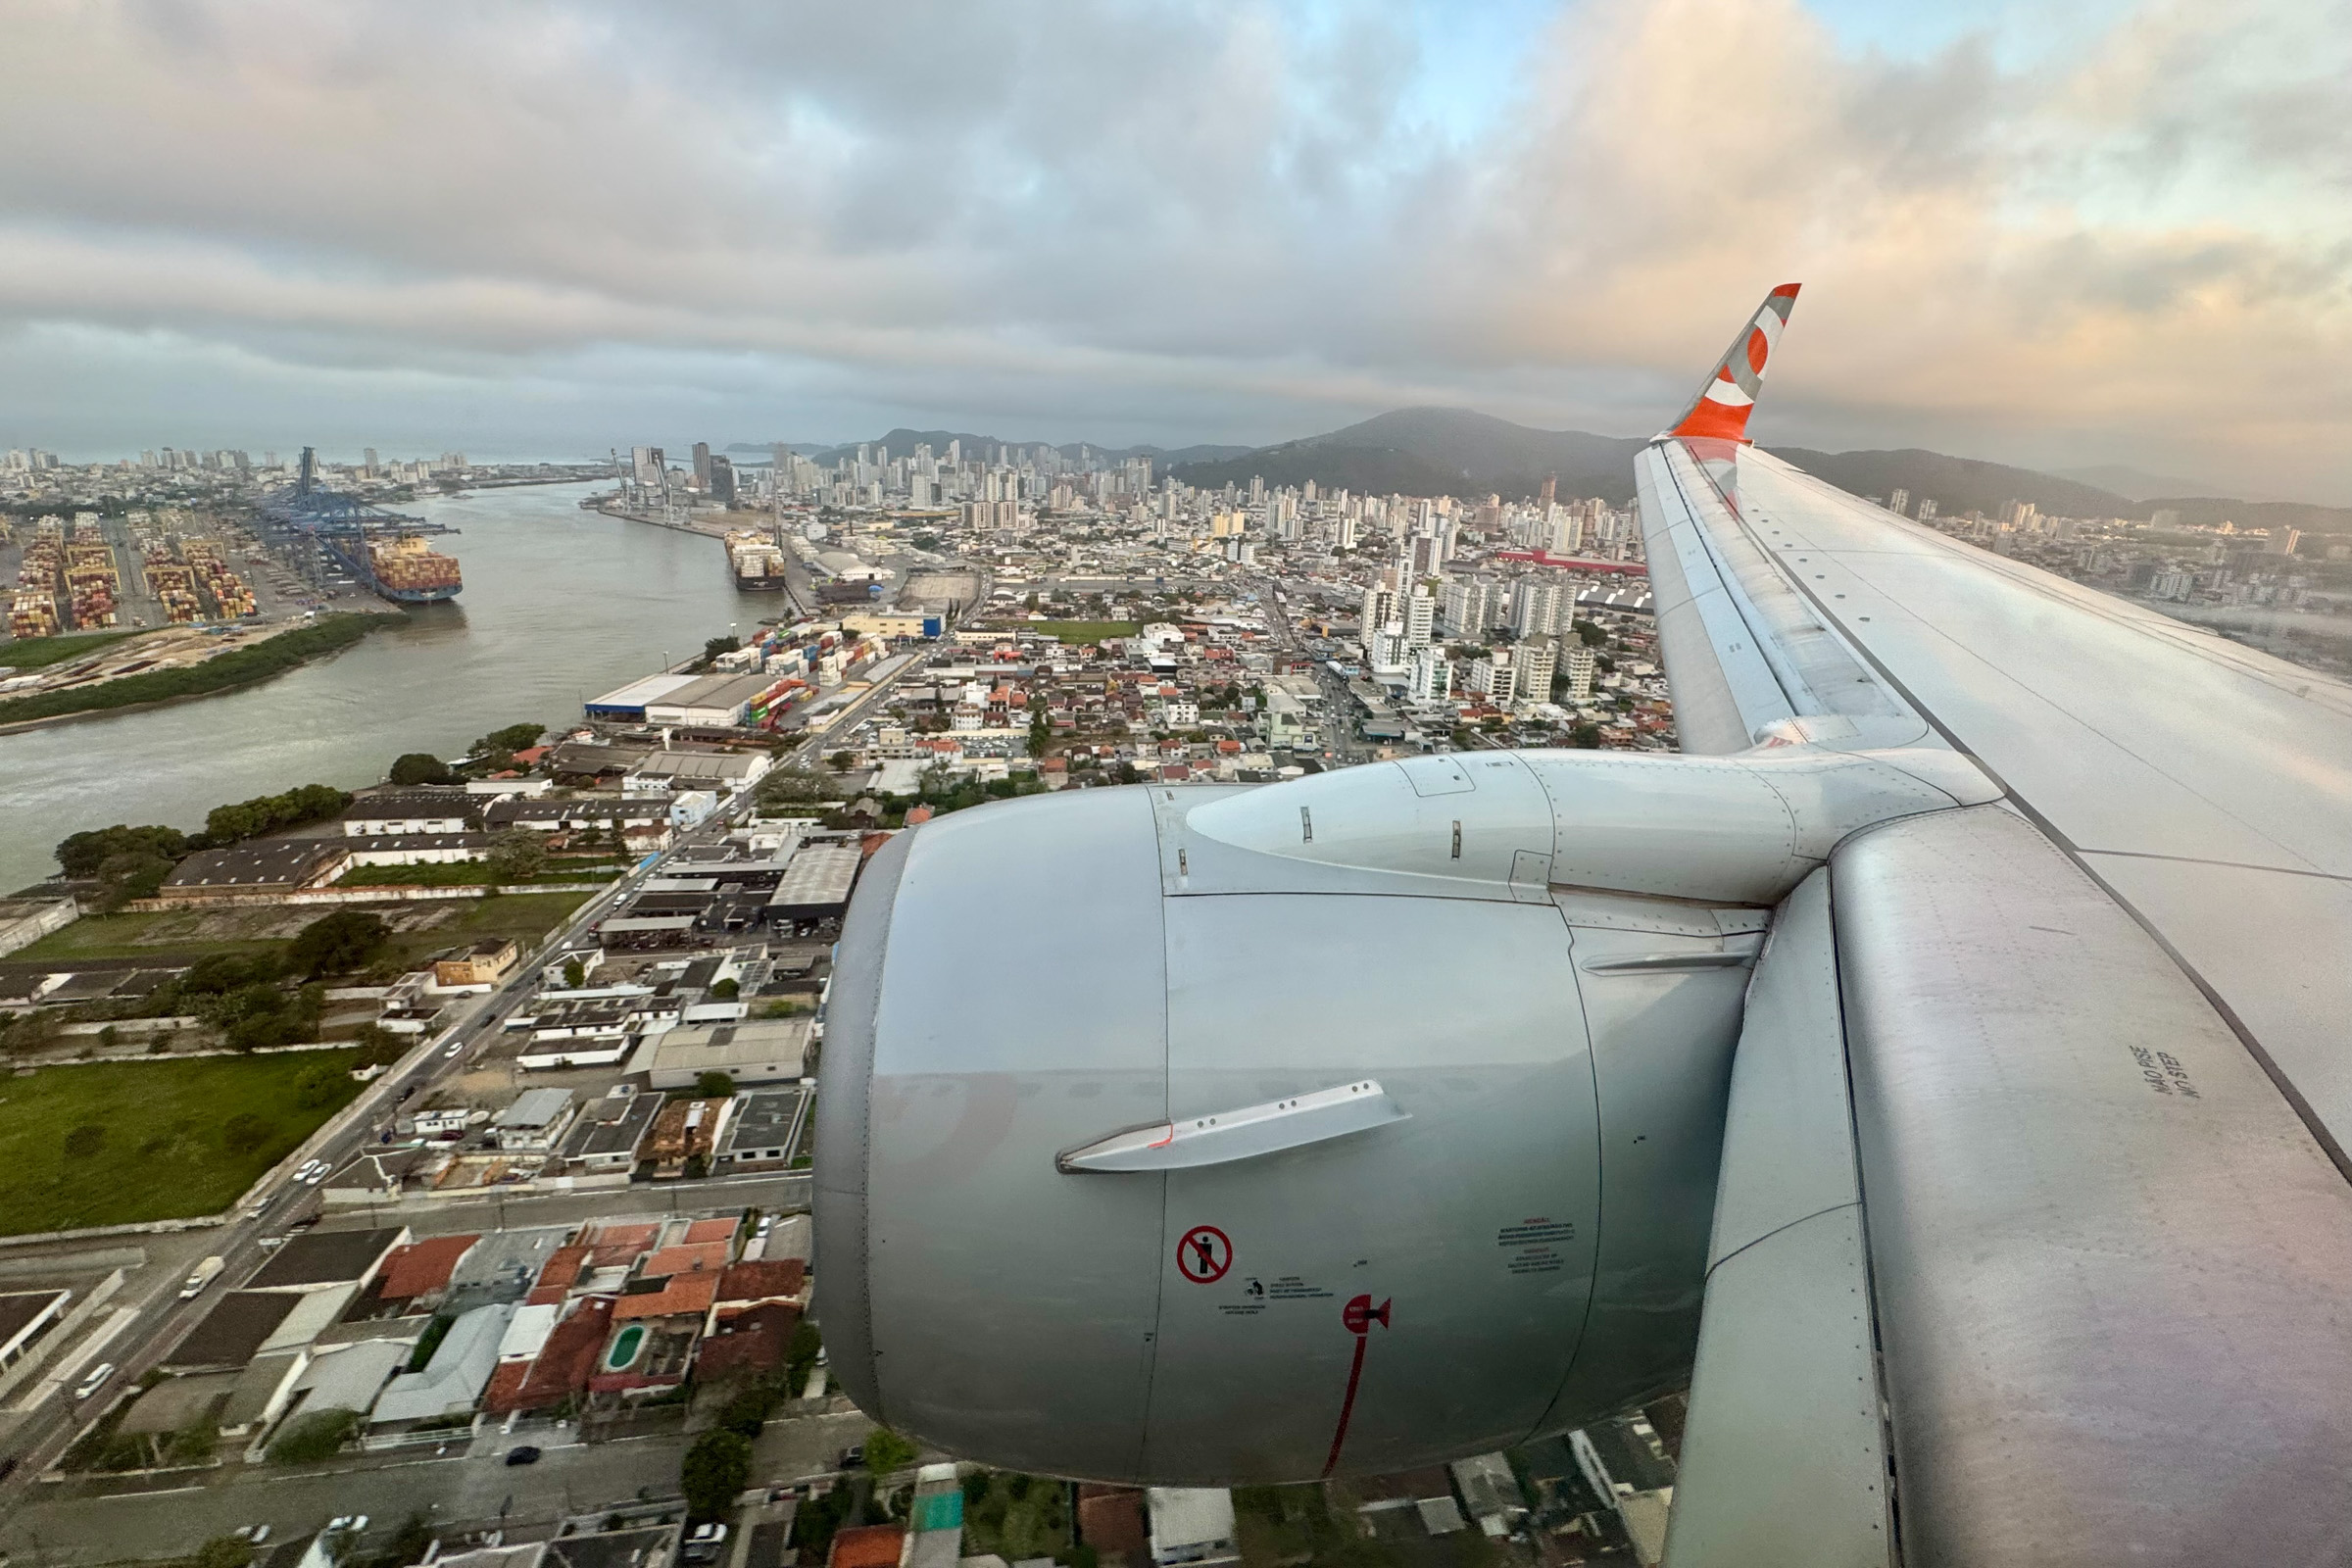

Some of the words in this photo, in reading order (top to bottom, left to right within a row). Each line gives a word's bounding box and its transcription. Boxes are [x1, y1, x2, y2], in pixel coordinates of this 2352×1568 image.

[2129, 1045, 2157, 1069] PISE
[2156, 1052, 2188, 1079] STEP
[2143, 1070, 2173, 1095] NÃO
[2174, 1080, 2200, 1099] NO
